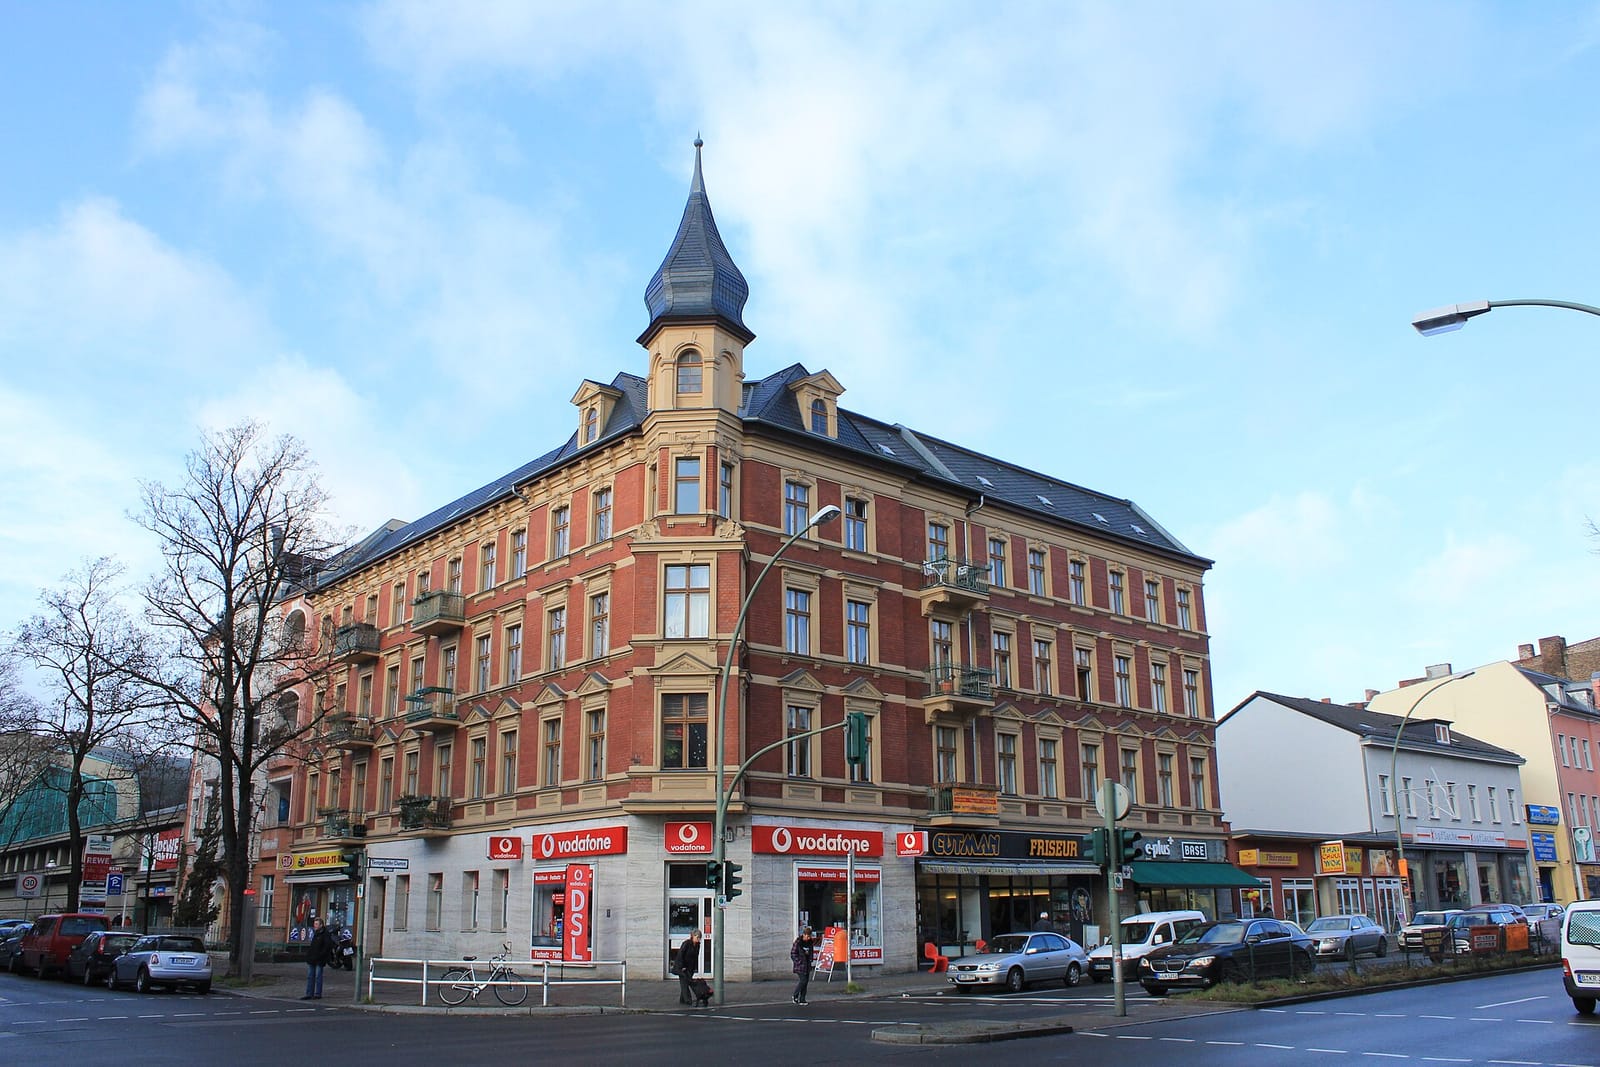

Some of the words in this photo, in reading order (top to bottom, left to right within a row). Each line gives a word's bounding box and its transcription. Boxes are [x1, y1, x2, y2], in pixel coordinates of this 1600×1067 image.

[558, 834, 611, 853] vodafone
[797, 834, 869, 852] vodafone
[1029, 838, 1078, 857] FRISEUR
[1184, 845, 1205, 856] BASE
[86, 856, 110, 864] REWE
[854, 950, 866, 958] 9,95
[867, 950, 879, 958] Euro
